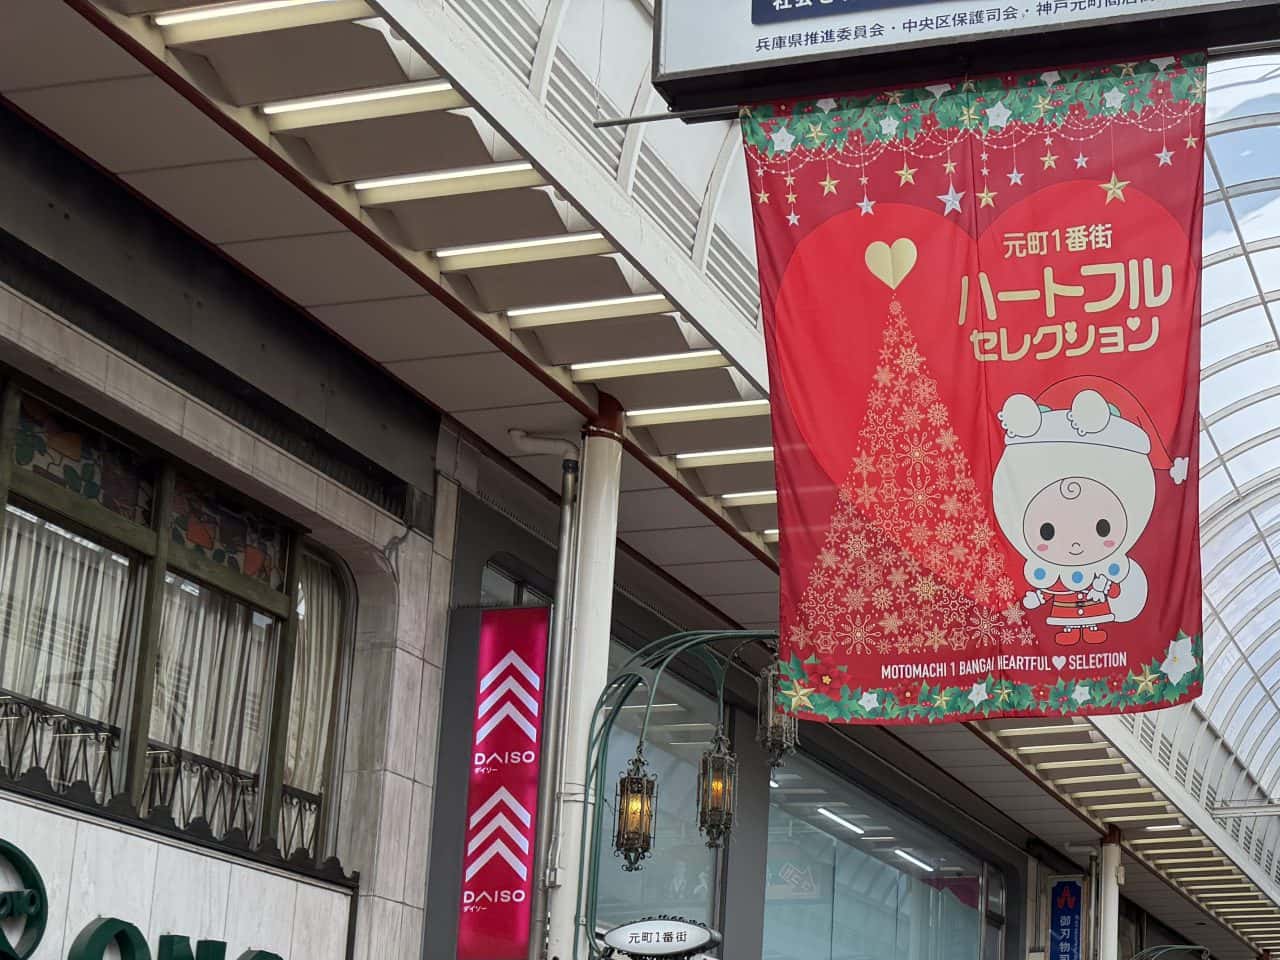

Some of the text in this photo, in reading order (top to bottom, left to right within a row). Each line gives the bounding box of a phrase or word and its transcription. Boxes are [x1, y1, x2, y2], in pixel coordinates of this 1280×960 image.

[1003, 224, 1112, 258] 元町1番街
[958, 258, 1172, 325] ハートフル
[970, 316, 1159, 361] セレクション
[881, 652, 1128, 680] MOTOMACHI 1 BANGAI HEARTFUL SELECTION
[474, 750, 535, 765] DAISO
[463, 889, 526, 904] DAISO
[628, 930, 687, 944] 元町1番街
